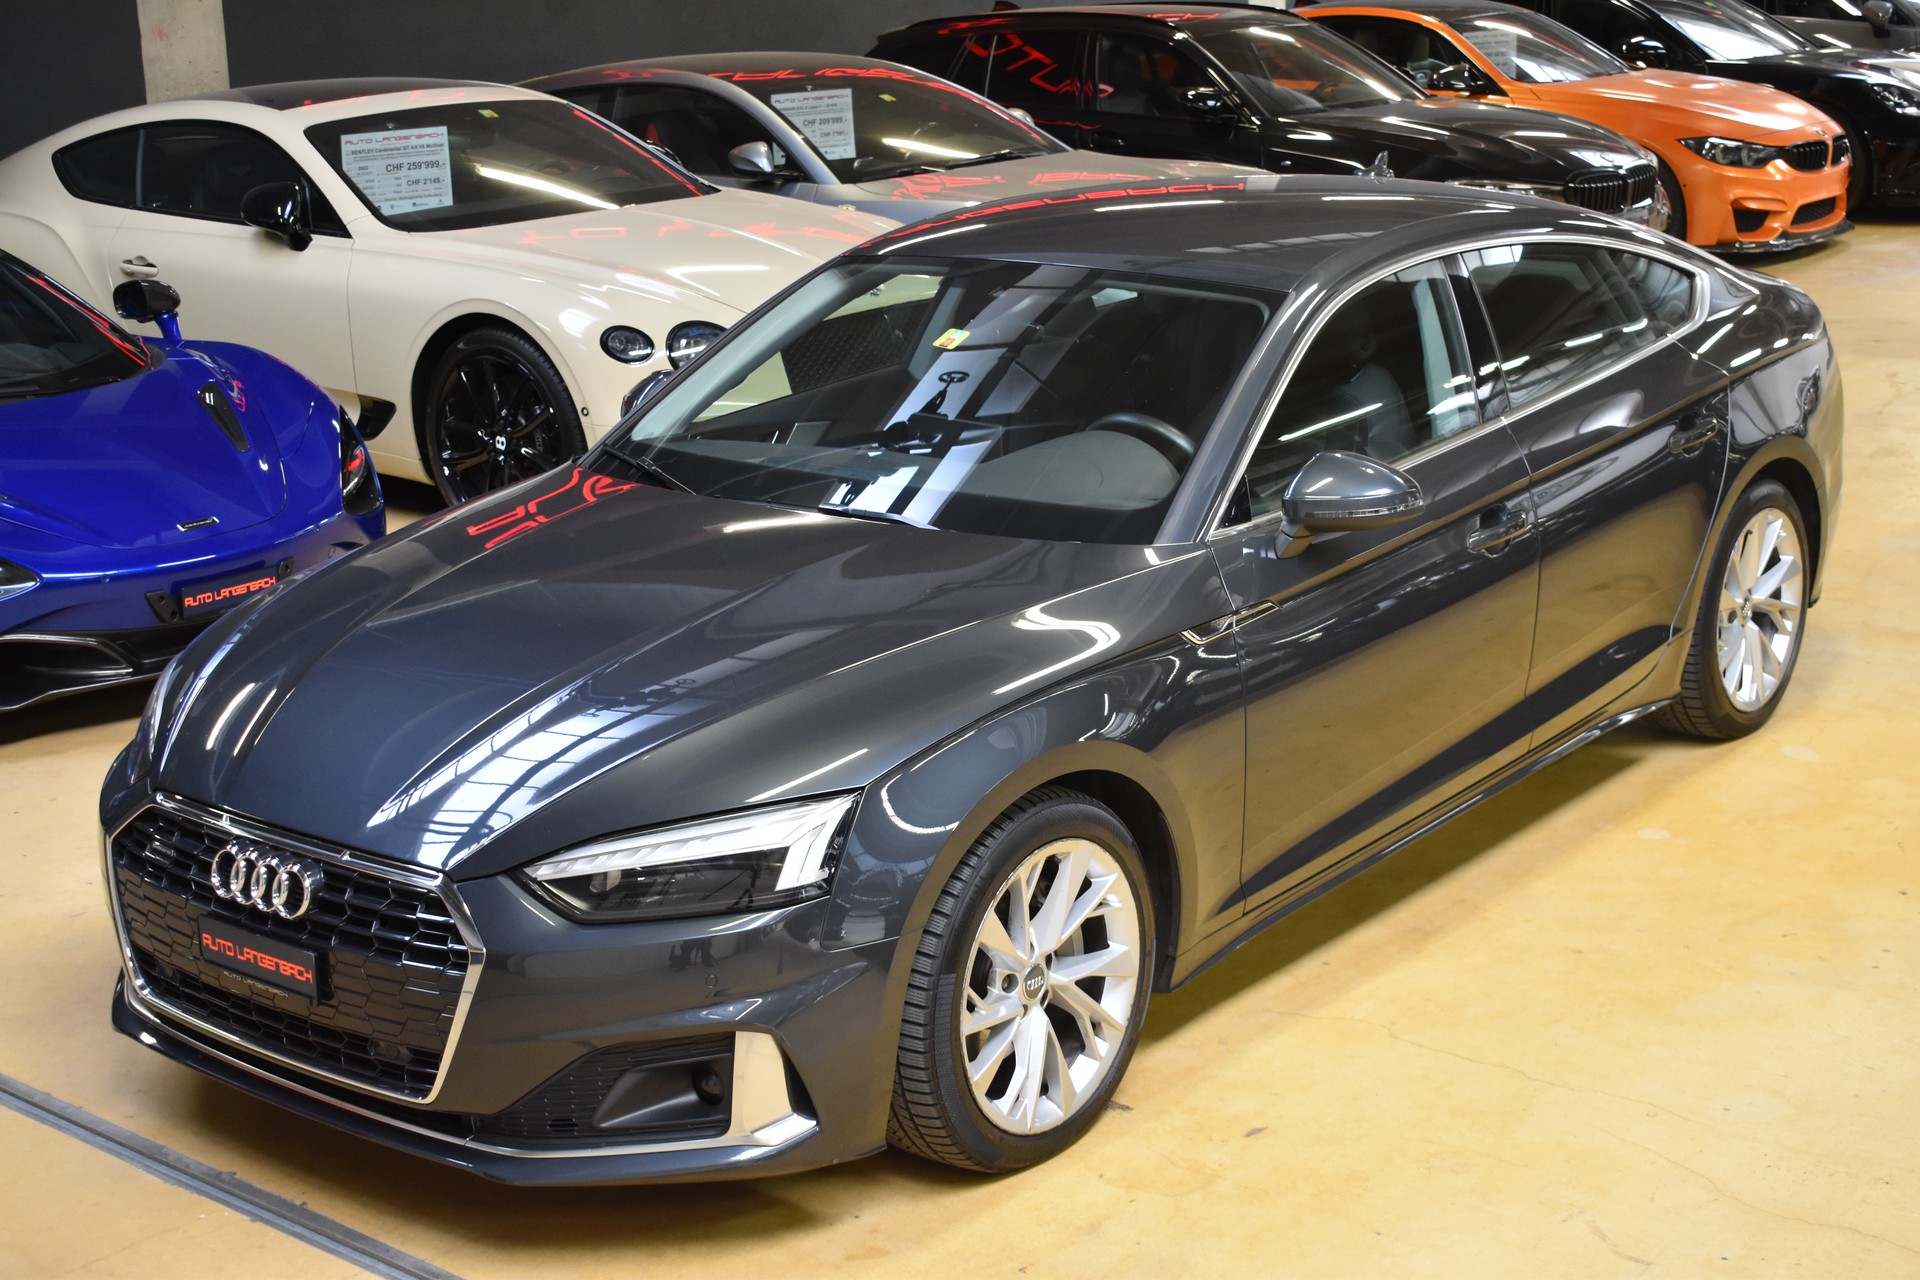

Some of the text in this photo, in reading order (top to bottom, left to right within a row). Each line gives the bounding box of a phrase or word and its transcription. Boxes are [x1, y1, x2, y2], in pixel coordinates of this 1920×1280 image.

[803, 118, 817, 127] CHF
[375, 133, 444, 143] LANGENBACH
[385, 160, 446, 173] CHF 259'999.-
[406, 179, 421, 187] CHF
[184, 576, 277, 608] AUTO LANGENBACH
[201, 933, 313, 984] AUTO LANGENBACH
[223, 971, 289, 997] AUTO LANGENBACH
